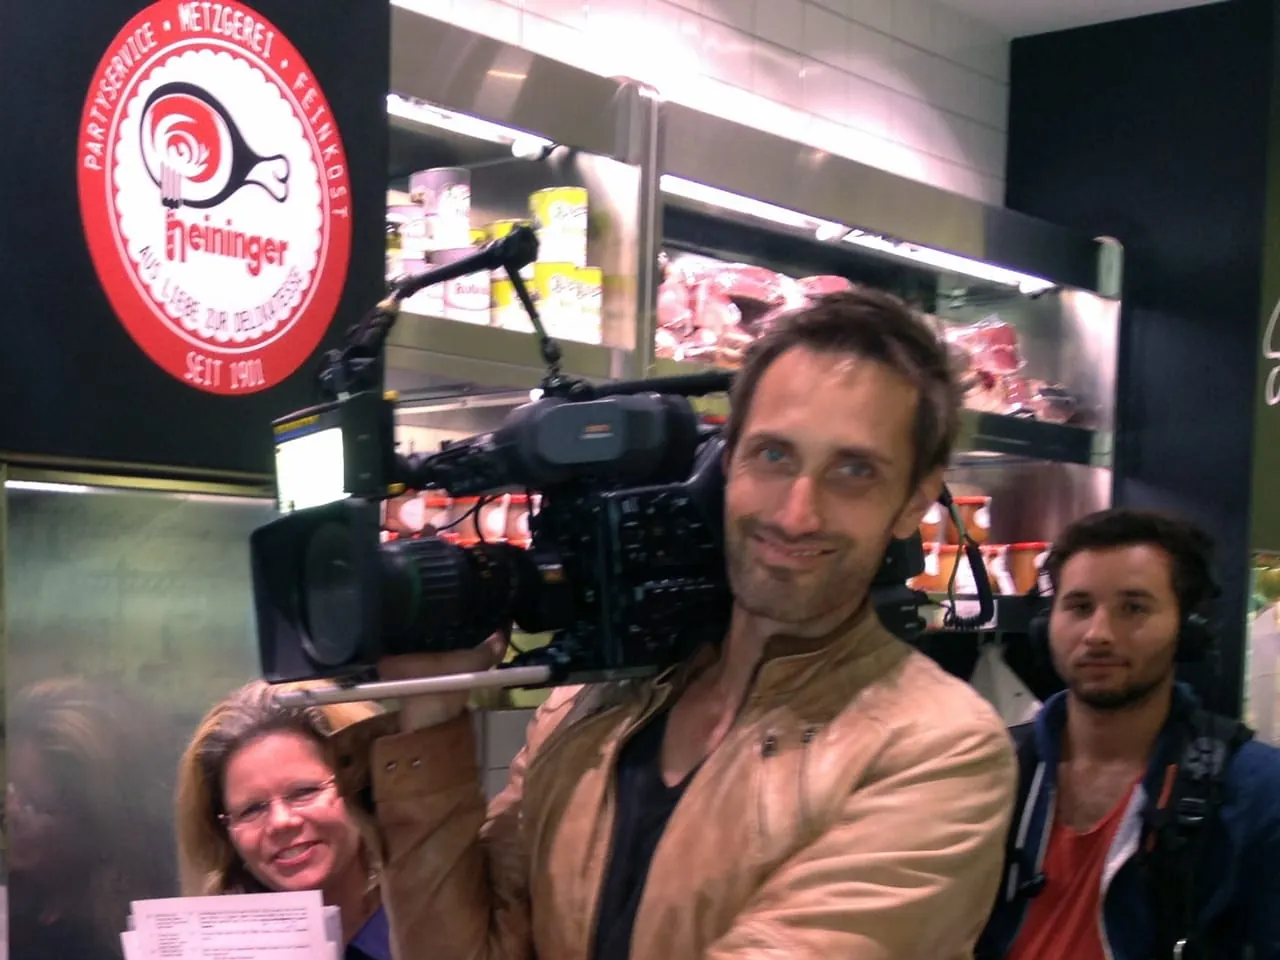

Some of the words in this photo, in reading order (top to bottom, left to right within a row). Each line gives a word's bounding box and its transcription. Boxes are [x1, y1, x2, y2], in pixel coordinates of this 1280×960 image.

[83, 21, 158, 171] PARTYSERVICE
[178, 1, 274, 59] METZGEREI
[292, 71, 349, 219] FEINKOST
[165, 209, 289, 276] heininger
[183, 351, 223, 387] SEIT
